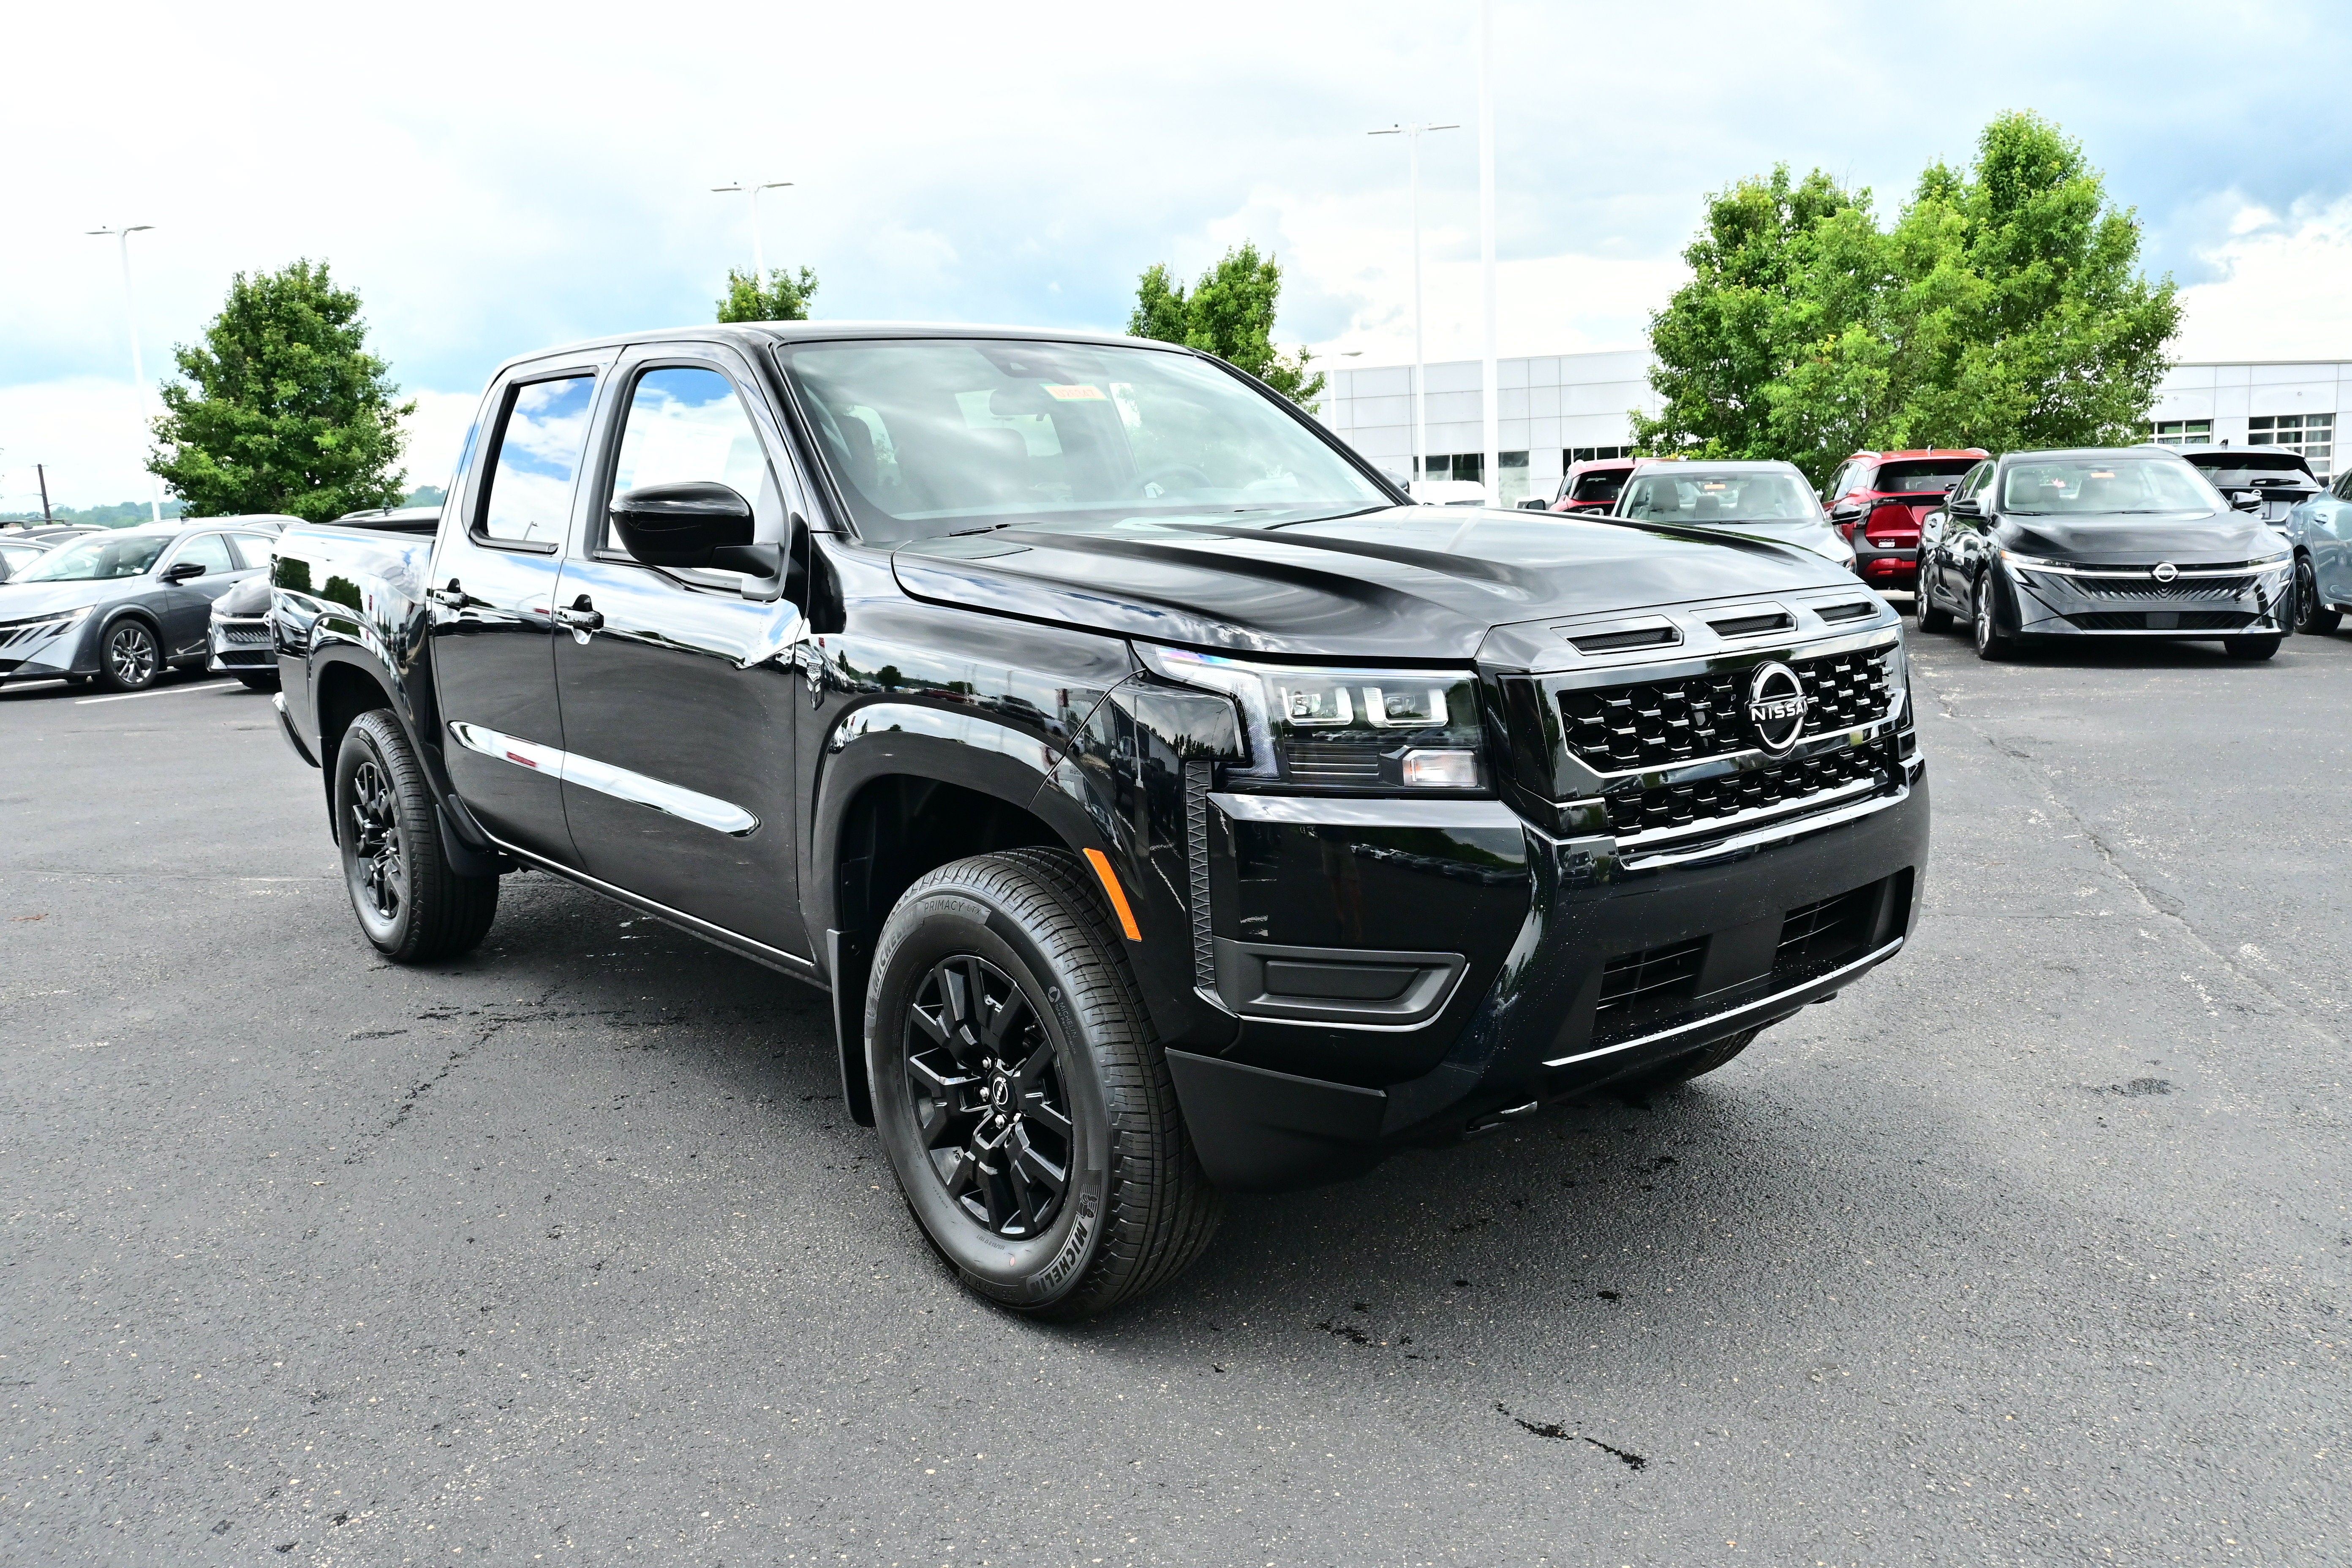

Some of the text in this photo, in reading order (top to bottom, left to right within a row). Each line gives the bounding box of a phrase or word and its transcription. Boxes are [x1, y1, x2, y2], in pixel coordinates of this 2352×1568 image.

[1751, 700, 1808, 721] NISSAN
[924, 900, 981, 915] PRIMACY LTX
[1054, 1004, 1077, 1054] Total Performance
[1059, 1002, 1078, 1038] MICHELIN
[1030, 1220, 1088, 1294] MICHELIN
